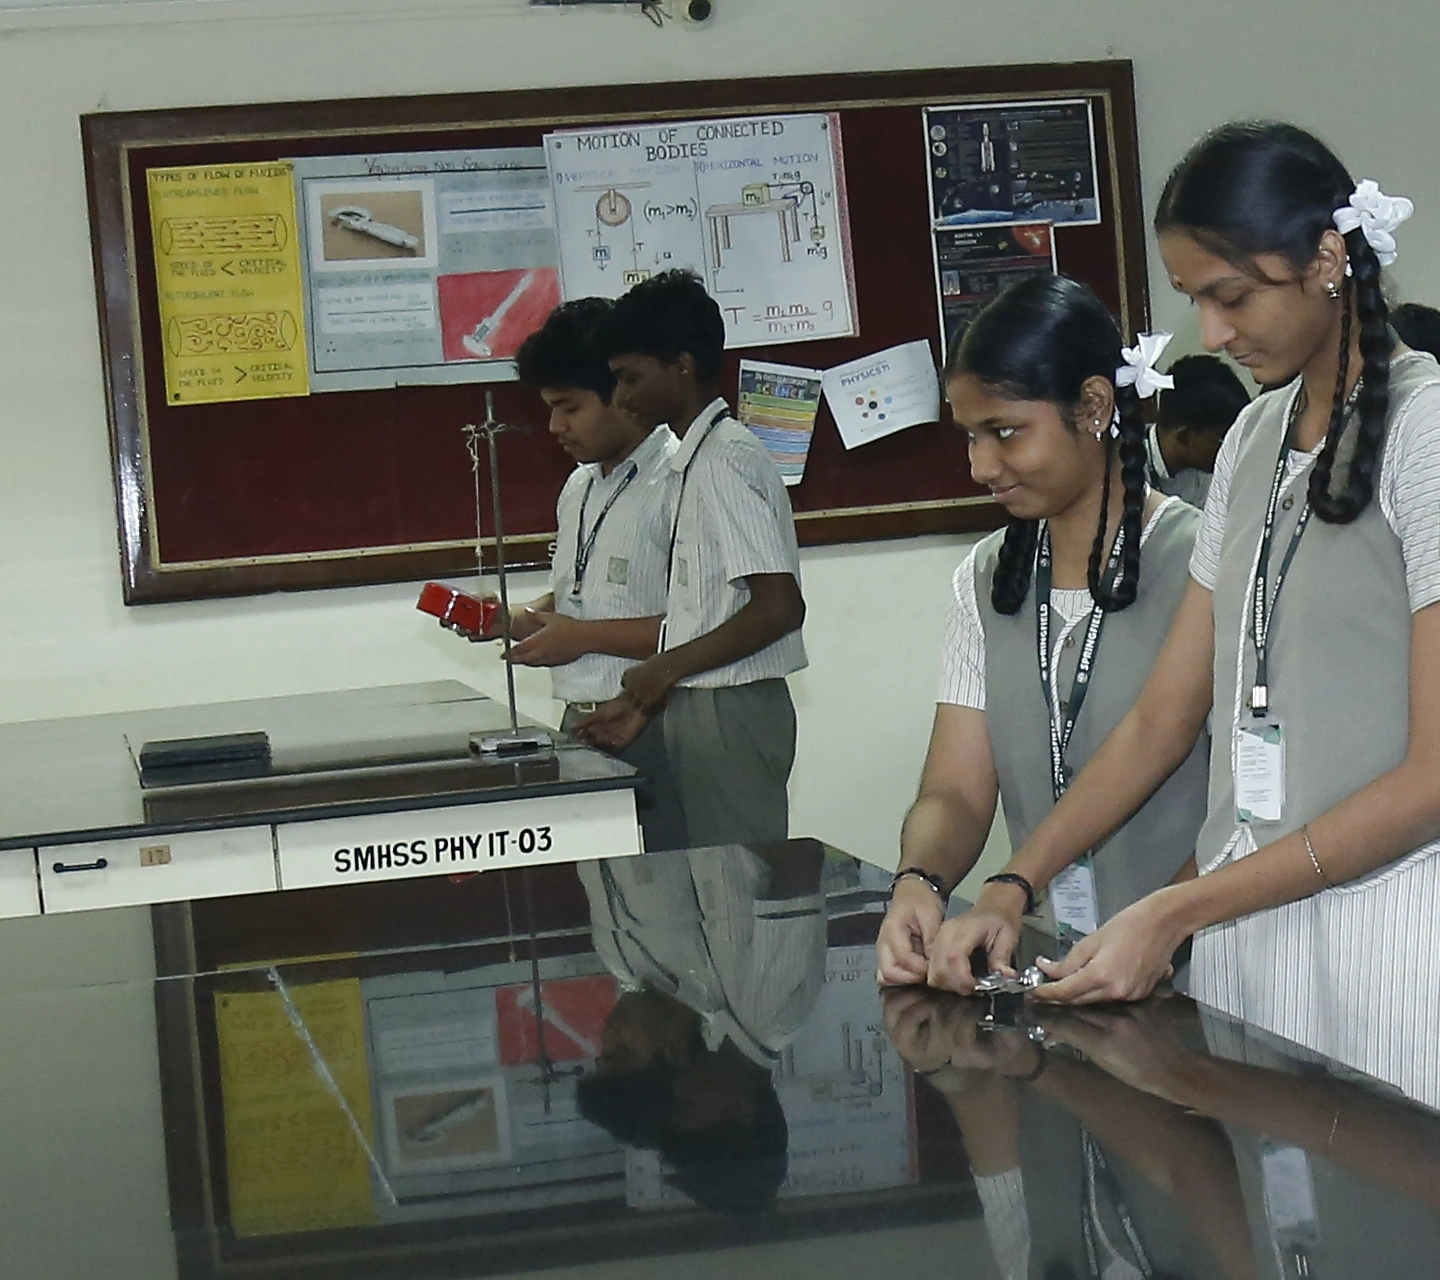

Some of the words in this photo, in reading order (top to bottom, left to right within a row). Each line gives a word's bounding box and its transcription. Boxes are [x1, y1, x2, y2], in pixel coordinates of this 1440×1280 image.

[577, 132, 641, 151] MOTION
[659, 129, 678, 144] OF
[697, 122, 784, 141] CONNECTED
[646, 143, 708, 162] BODIES
[773, 153, 818, 165] MOTION
[204, 171, 230, 180] FLOW
[724, 307, 746, 325] T
[1256, 576, 1264, 648] SPRINGFIELD
[1040, 604, 1049, 668] SPRINGFIELD
[334, 840, 428, 873] SMHSS
[434, 833, 483, 863] PHY
[488, 826, 553, 857] IT-03
